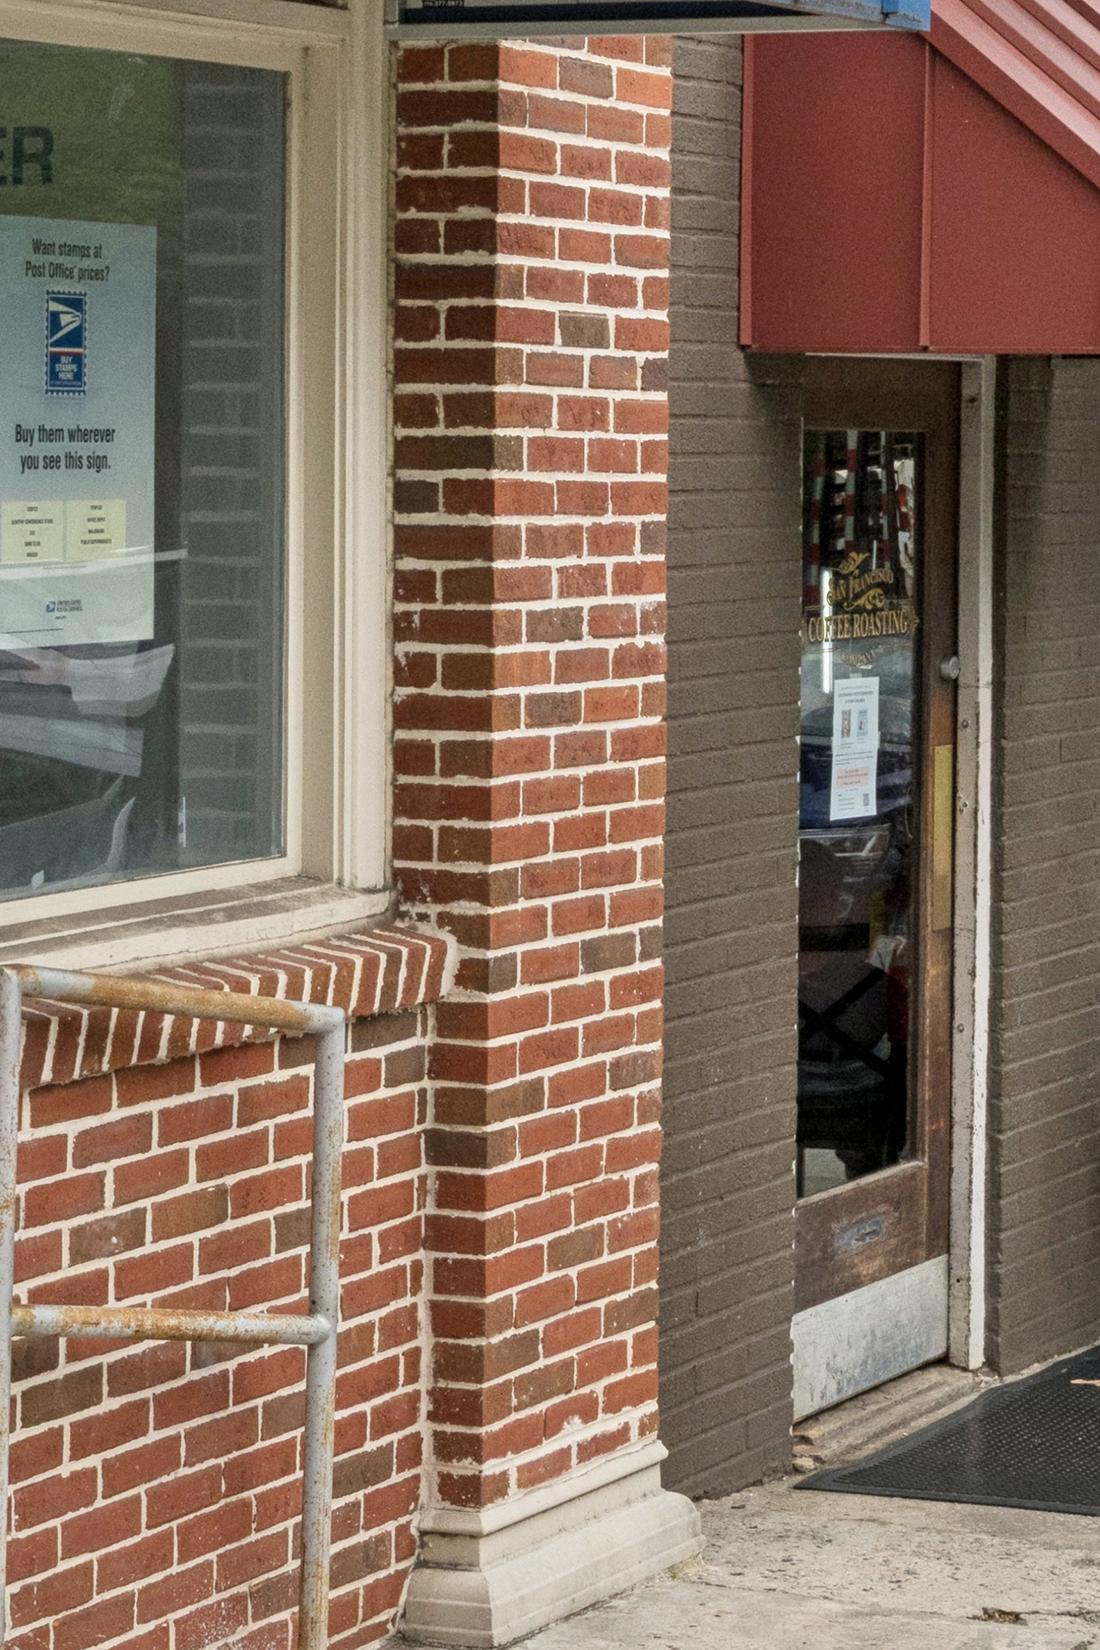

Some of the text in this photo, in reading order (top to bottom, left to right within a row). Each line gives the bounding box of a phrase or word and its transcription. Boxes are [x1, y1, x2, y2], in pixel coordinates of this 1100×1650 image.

[32, 238, 103, 260] Want stamps at
[25, 261, 46, 278] Post
[77, 266, 110, 282] prices?
[55, 363, 78, 372] STAMPS
[60, 355, 73, 364] BUY
[58, 371, 75, 380] HERE
[15, 424, 116, 447] Buy them wherever
[20, 451, 111, 474] you see this sign.
[827, 568, 894, 606] SAN FRANCISCO
[809, 610, 908, 642] COFFEE ROASTING
